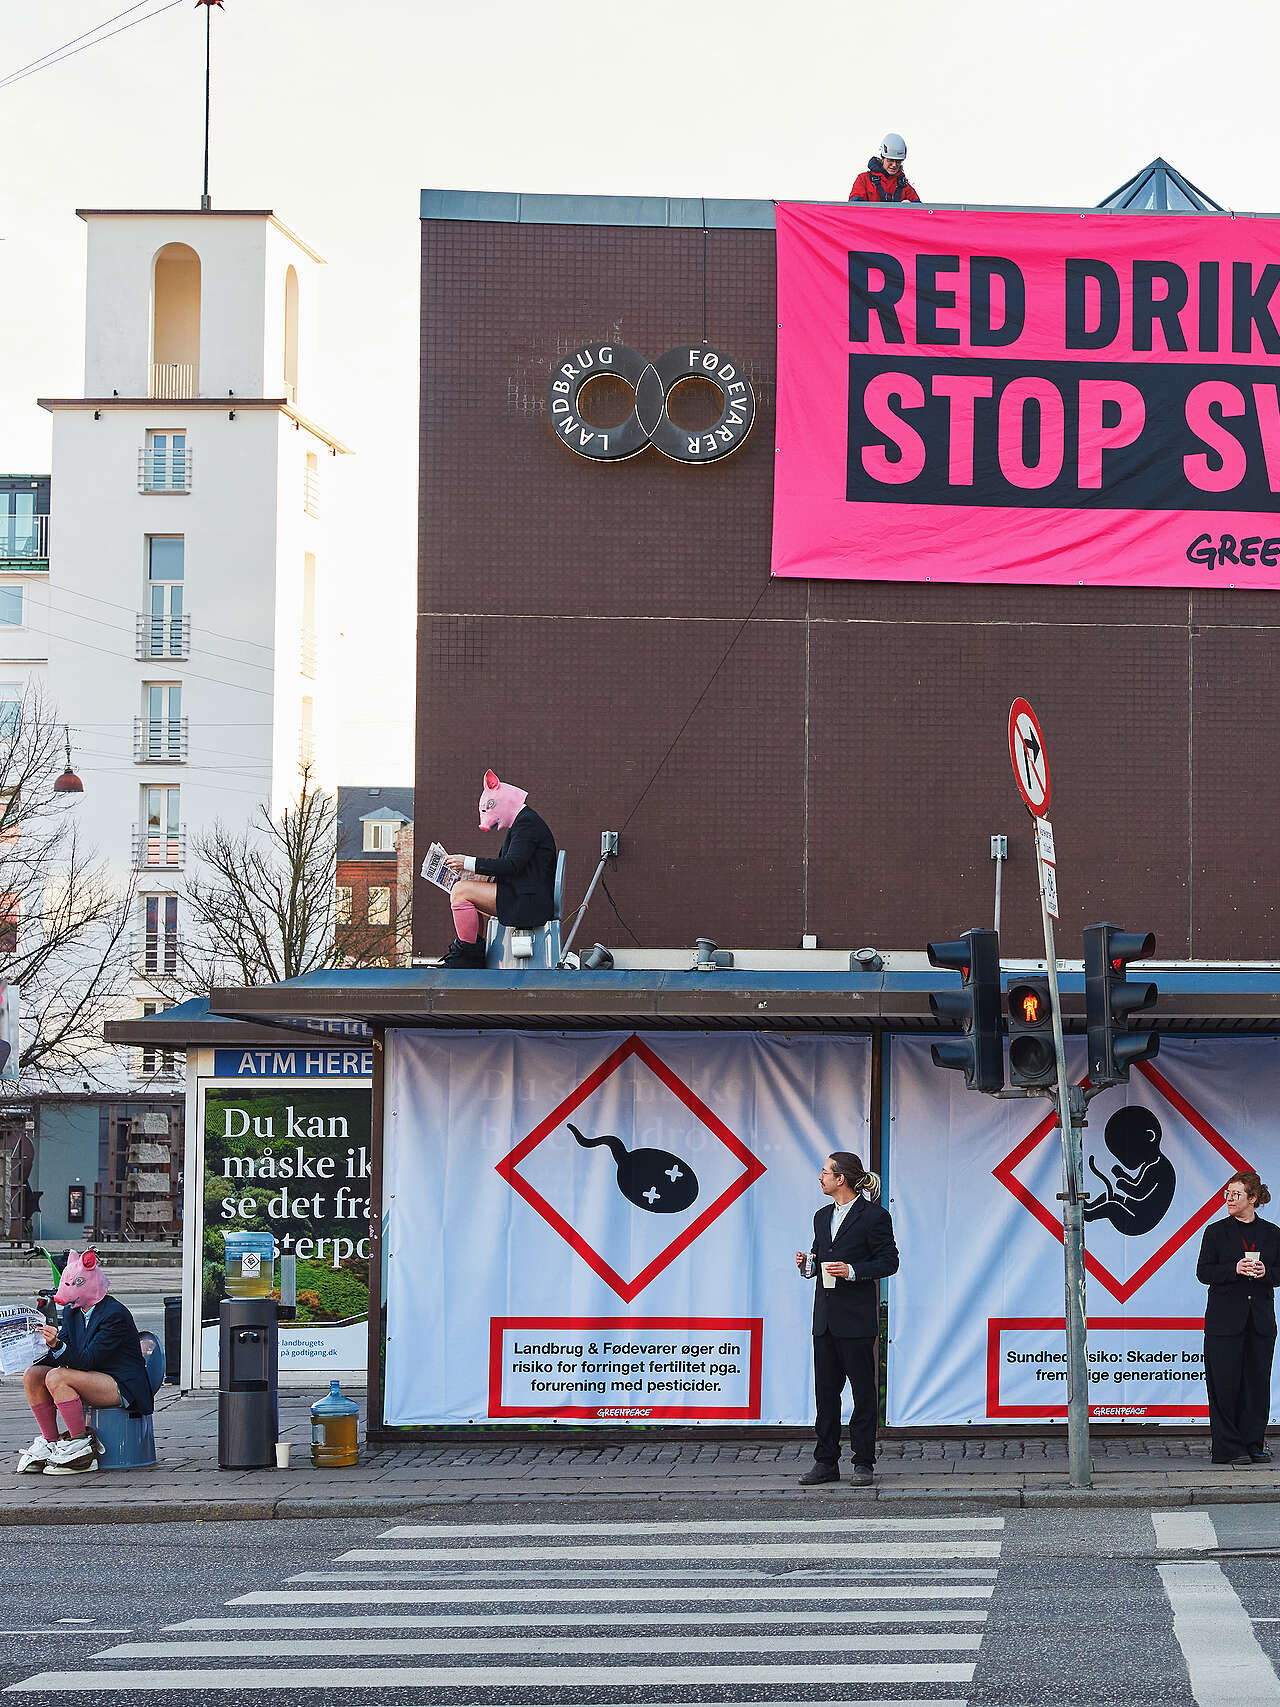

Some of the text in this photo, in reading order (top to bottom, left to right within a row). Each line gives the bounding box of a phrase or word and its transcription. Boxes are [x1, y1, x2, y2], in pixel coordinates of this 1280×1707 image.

[848, 251, 1026, 346] RED
[552, 346, 613, 451] LANDBRUG
[687, 350, 748, 454] FØDEVARER
[861, 371, 1146, 490] STOP
[238, 1052, 373, 1074] ATM HERE
[222, 1106, 350, 1139] Du kan
[222, 1146, 372, 1179] måske ik
[221, 1195, 257, 1219] se
[267, 1187, 325, 1219] det
[281, 1339, 324, 1348] landbrugets
[514, 1342, 741, 1357] Landbrug & Fødevarer øger din
[280, 1348, 338, 1358] på godtigang.dk
[1127, 1350, 1177, 1363] Skader
[512, 1360, 741, 1376] risiko for forringet fertilitet pga.
[1036, 1369, 1110, 1384] fremige
[531, 1379, 722, 1394] forurening med pesticider.
[597, 1408, 653, 1418] GREENPEACE
[1093, 1406, 1148, 1416] GREENPEACE
